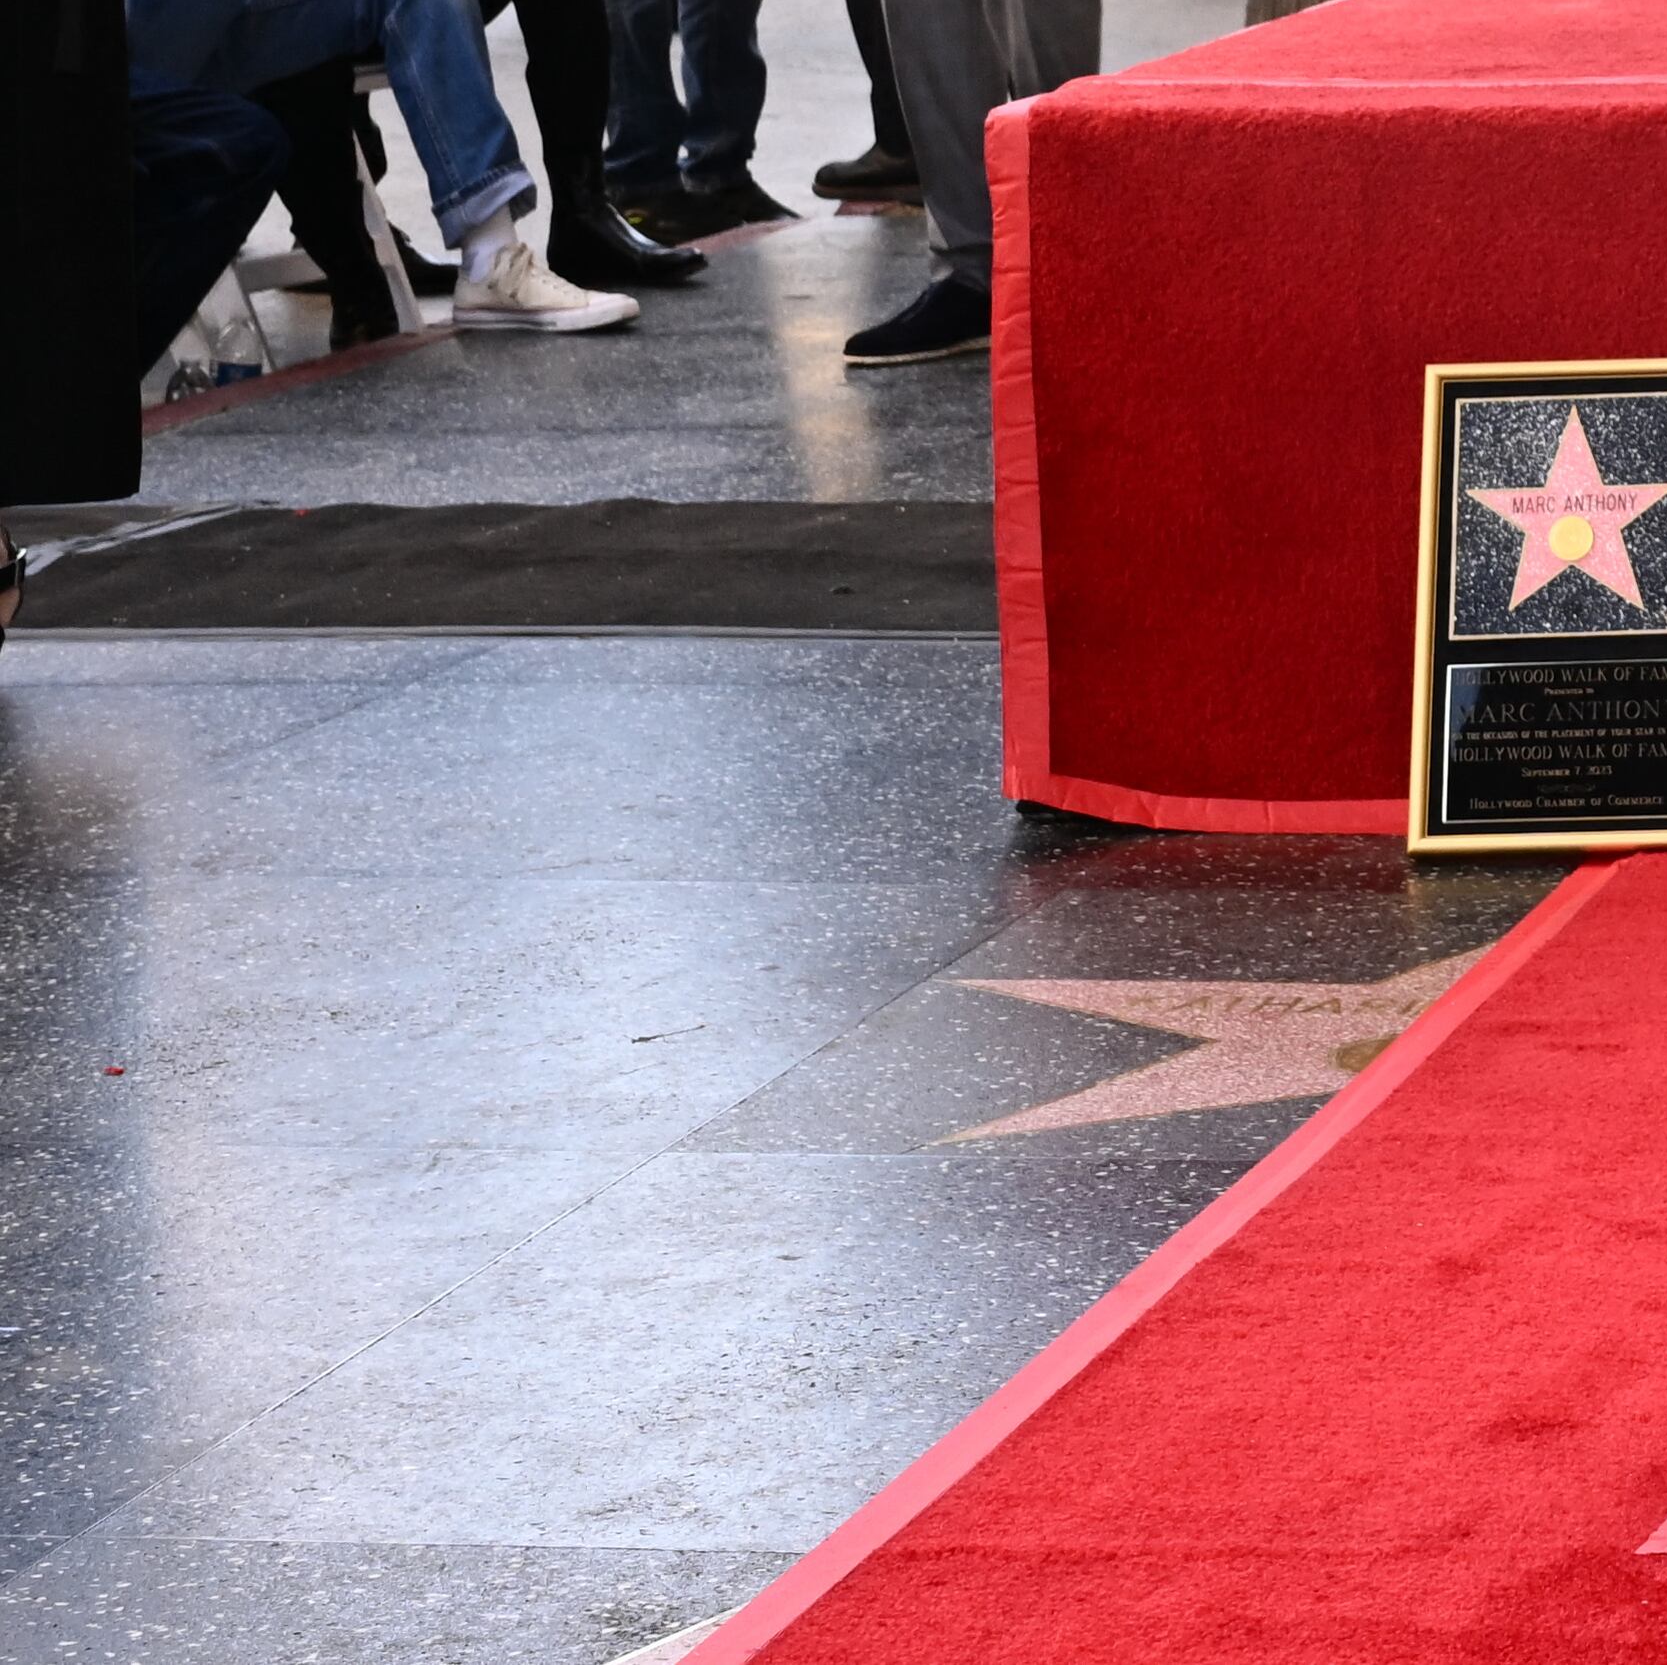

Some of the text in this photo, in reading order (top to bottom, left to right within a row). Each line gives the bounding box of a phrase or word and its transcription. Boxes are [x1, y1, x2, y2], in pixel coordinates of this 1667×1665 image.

[1512, 492, 1638, 514] MARC ANTHONY
[1453, 668, 1555, 686] HOLLYWOOD
[1561, 667, 1607, 683] WALK
[1613, 665, 1635, 682] OF
[1455, 701, 1536, 725] MARC
[1550, 727, 1595, 738] PLACEMENT
[1453, 745, 1553, 763] HOLLYWOOD
[1559, 743, 1606, 759] WALK
[1611, 742, 1633, 758] OF
[1469, 794, 1665, 810] HOLLYWOOD CHAMBER OF COMMERCE
